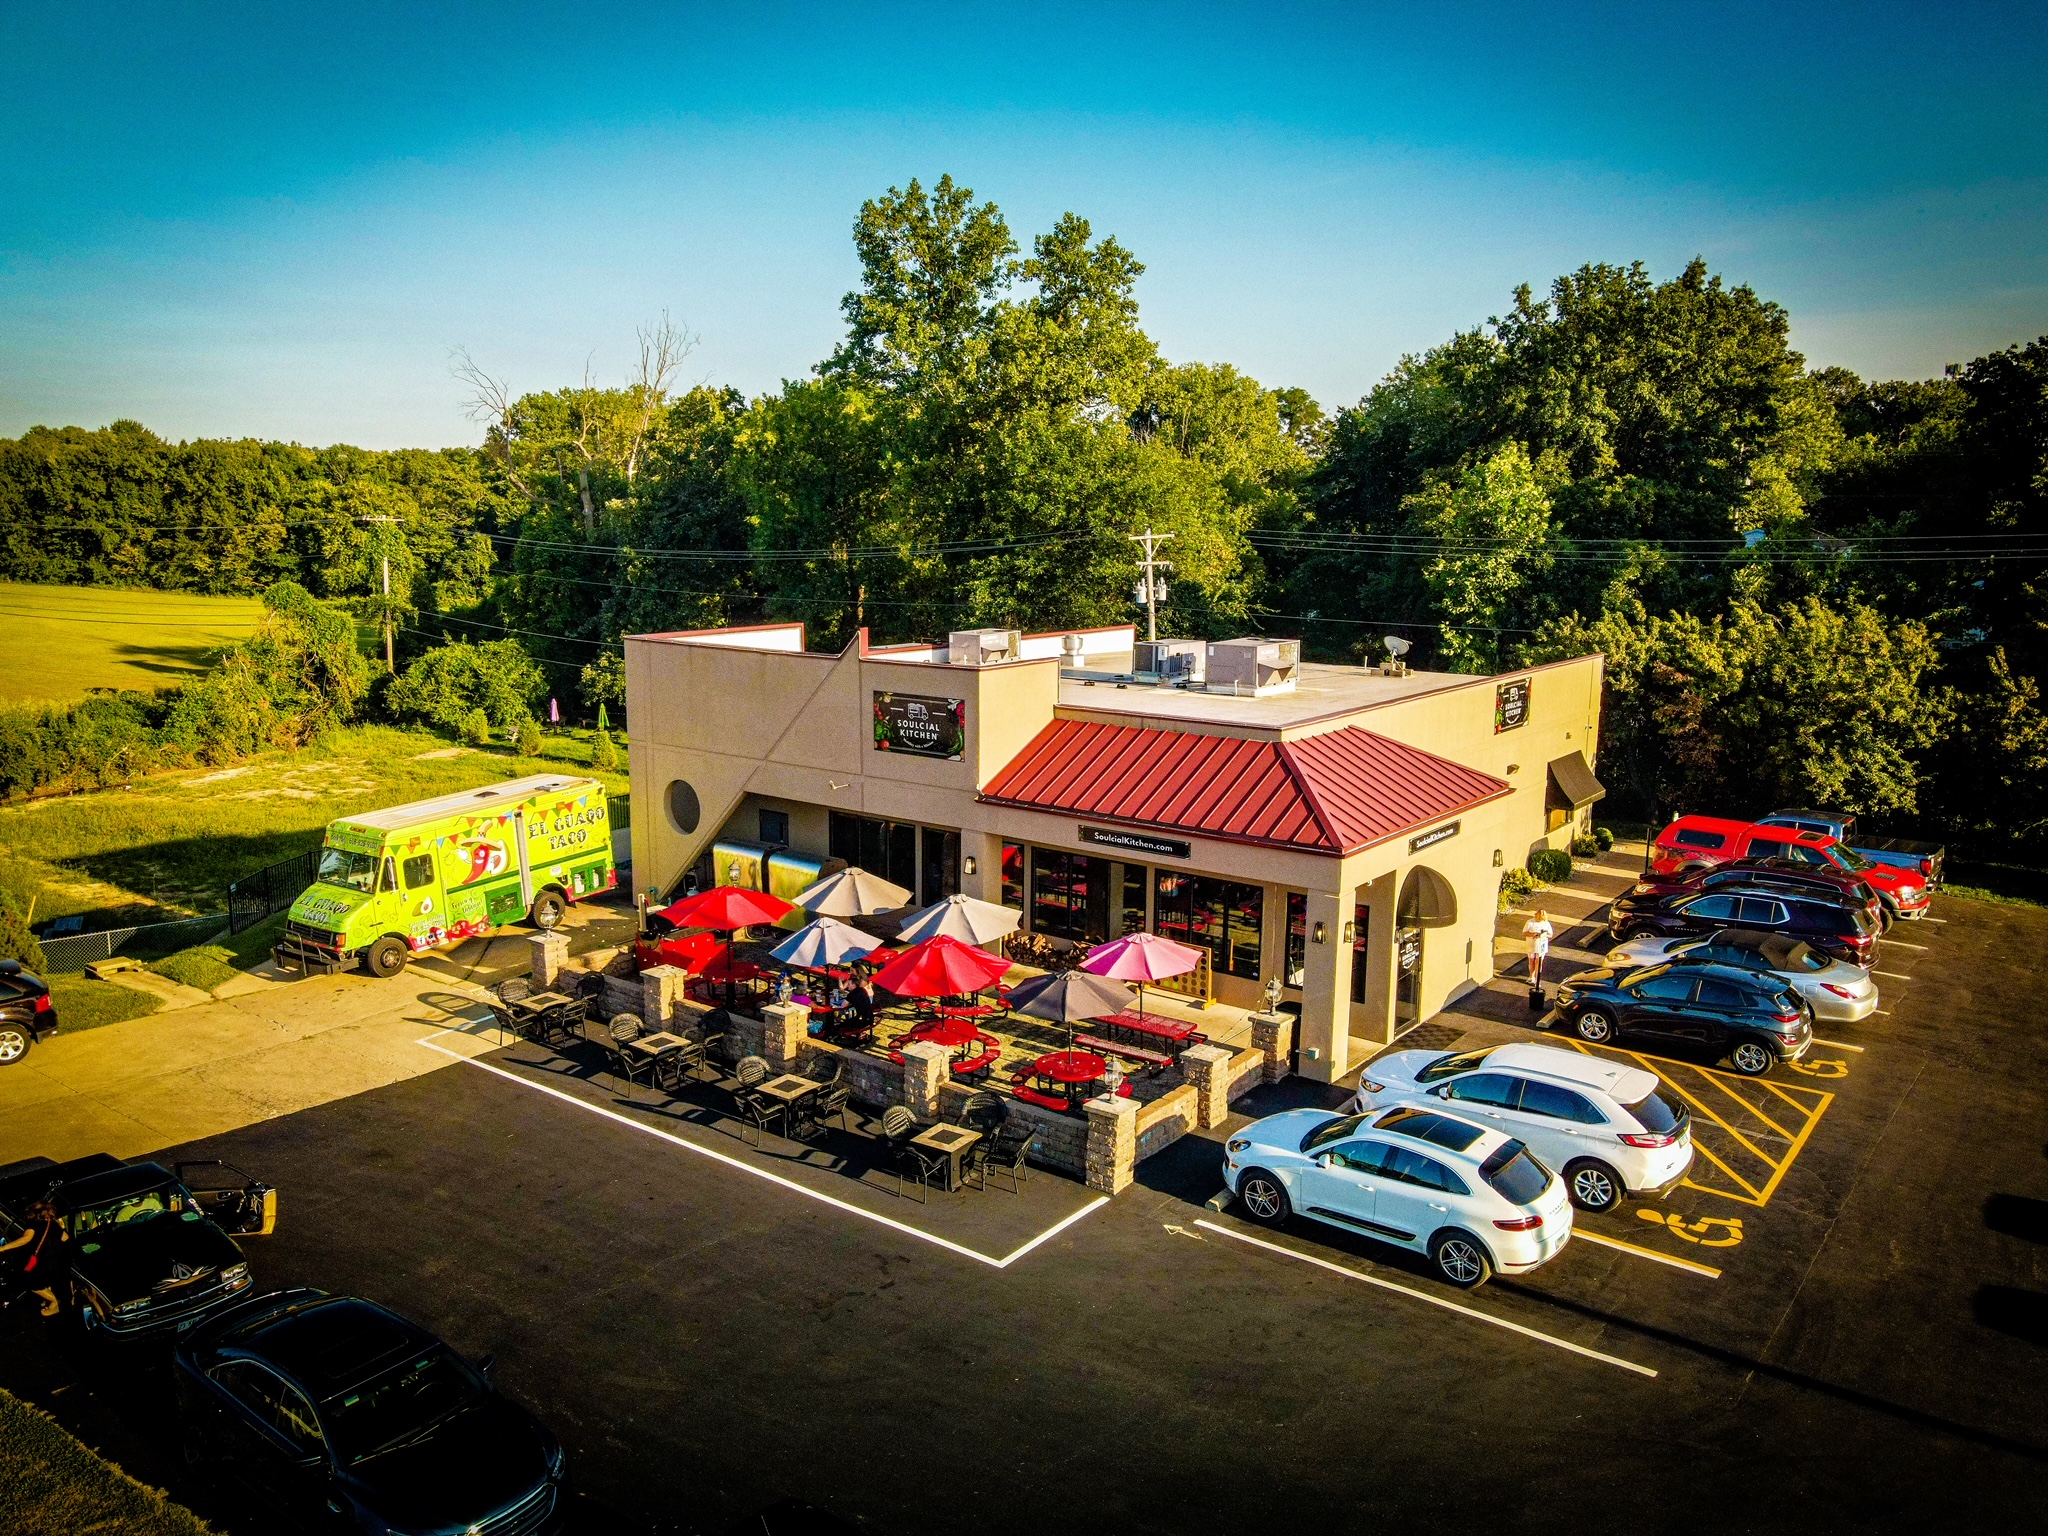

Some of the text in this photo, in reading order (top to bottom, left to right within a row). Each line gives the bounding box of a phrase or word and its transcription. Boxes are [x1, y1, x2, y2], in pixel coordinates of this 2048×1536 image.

[897, 719, 940, 732] SOULCIAL
[900, 729, 938, 740] KITCHEN
[528, 821, 549, 839] EL
[548, 829, 587, 850] TACO
[1094, 832, 1173, 852] SoulcialKitchen.com
